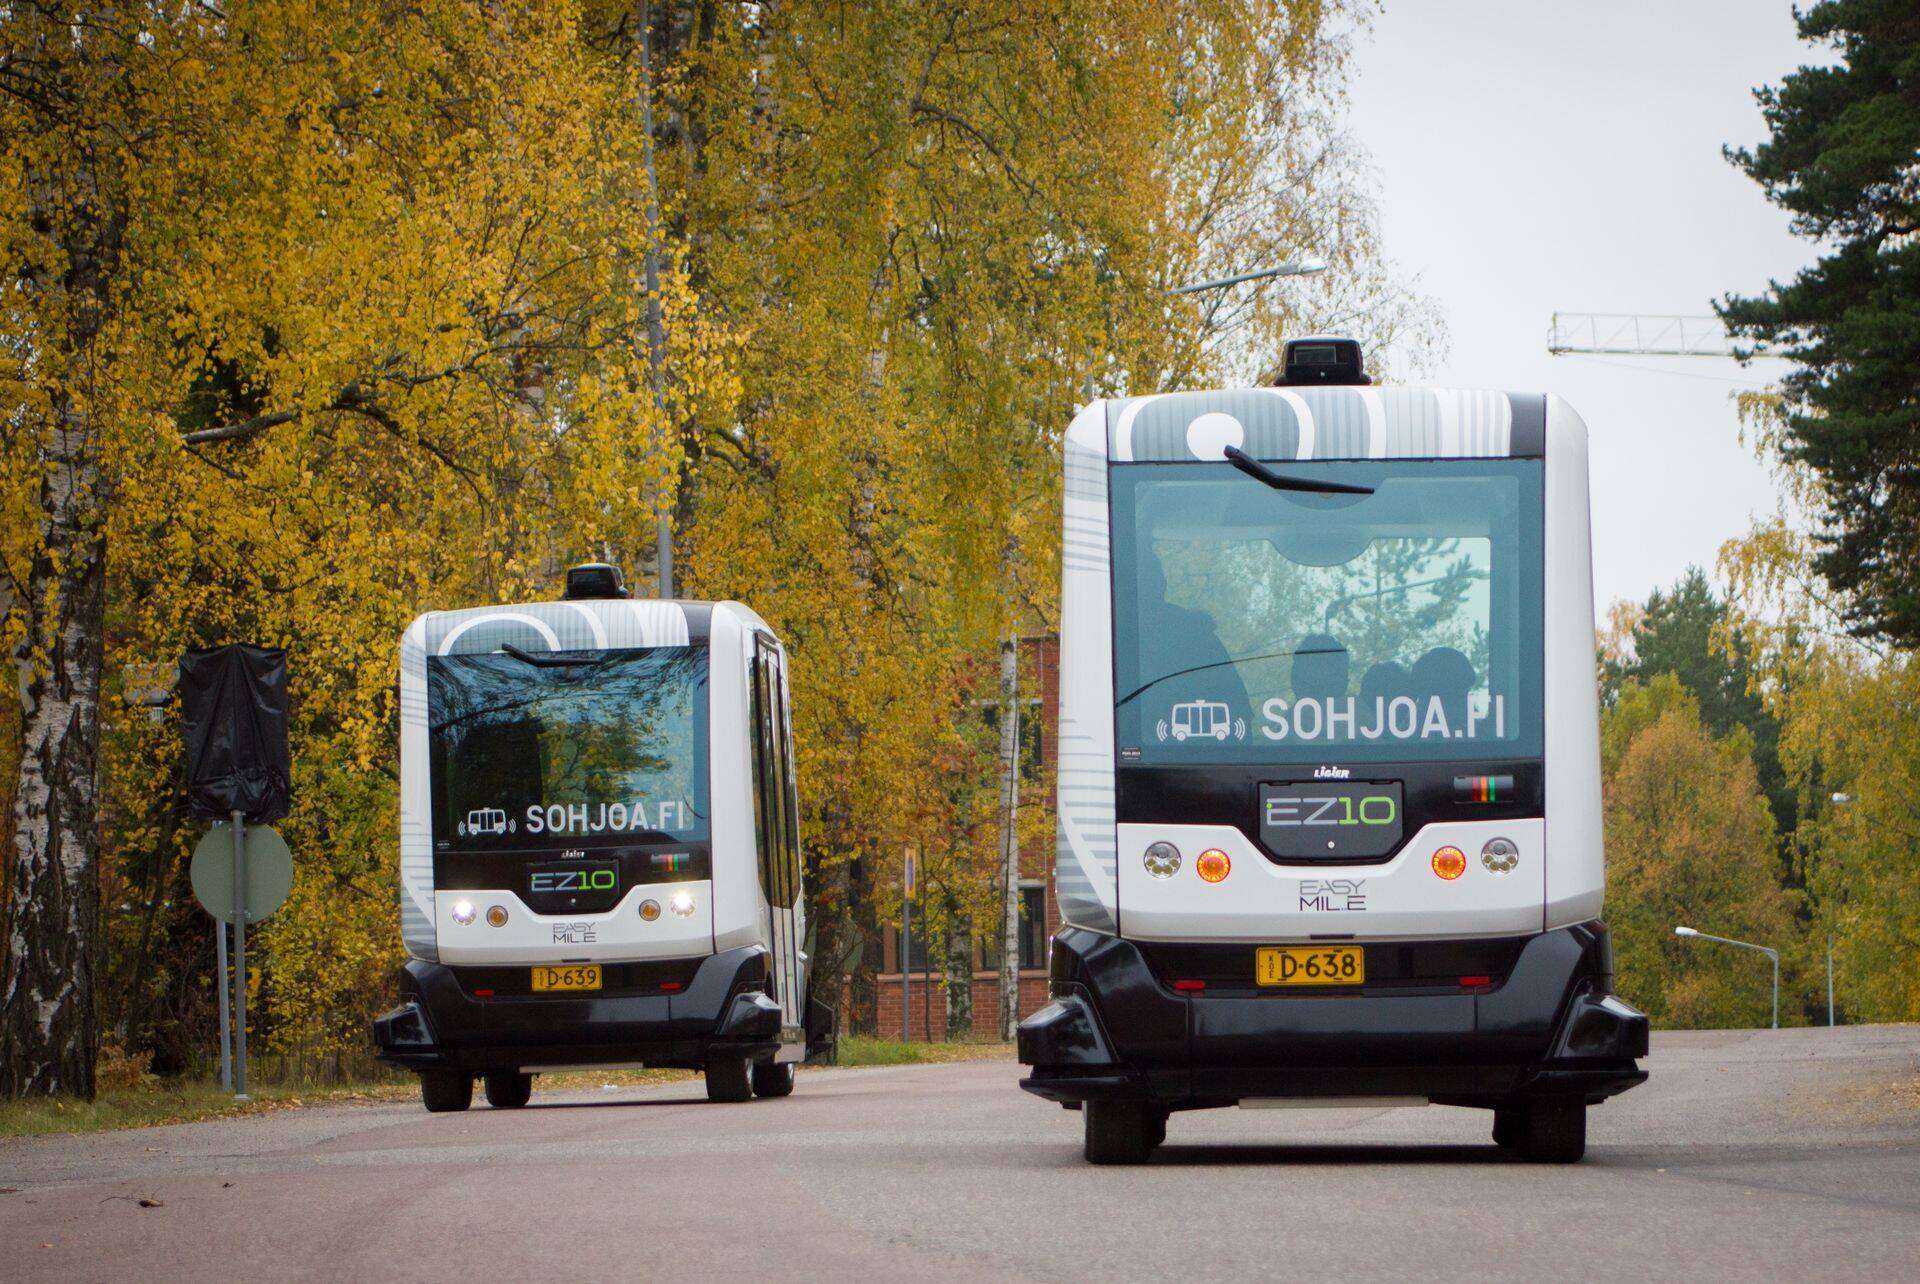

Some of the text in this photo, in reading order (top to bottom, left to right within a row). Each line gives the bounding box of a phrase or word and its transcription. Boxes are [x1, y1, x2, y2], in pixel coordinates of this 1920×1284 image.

[1261, 694, 1504, 740] SOHJOA.FI
[526, 800, 684, 833] SOHJOA.FI
[1266, 796, 1396, 826] EZ10
[531, 870, 615, 892] EZ10
[1299, 879, 1367, 895] EASY
[1299, 894, 1367, 912] MILE
[552, 922, 596, 934] EASY
[1280, 953, 1356, 978] D-638
[547, 969, 597, 986] D-639
